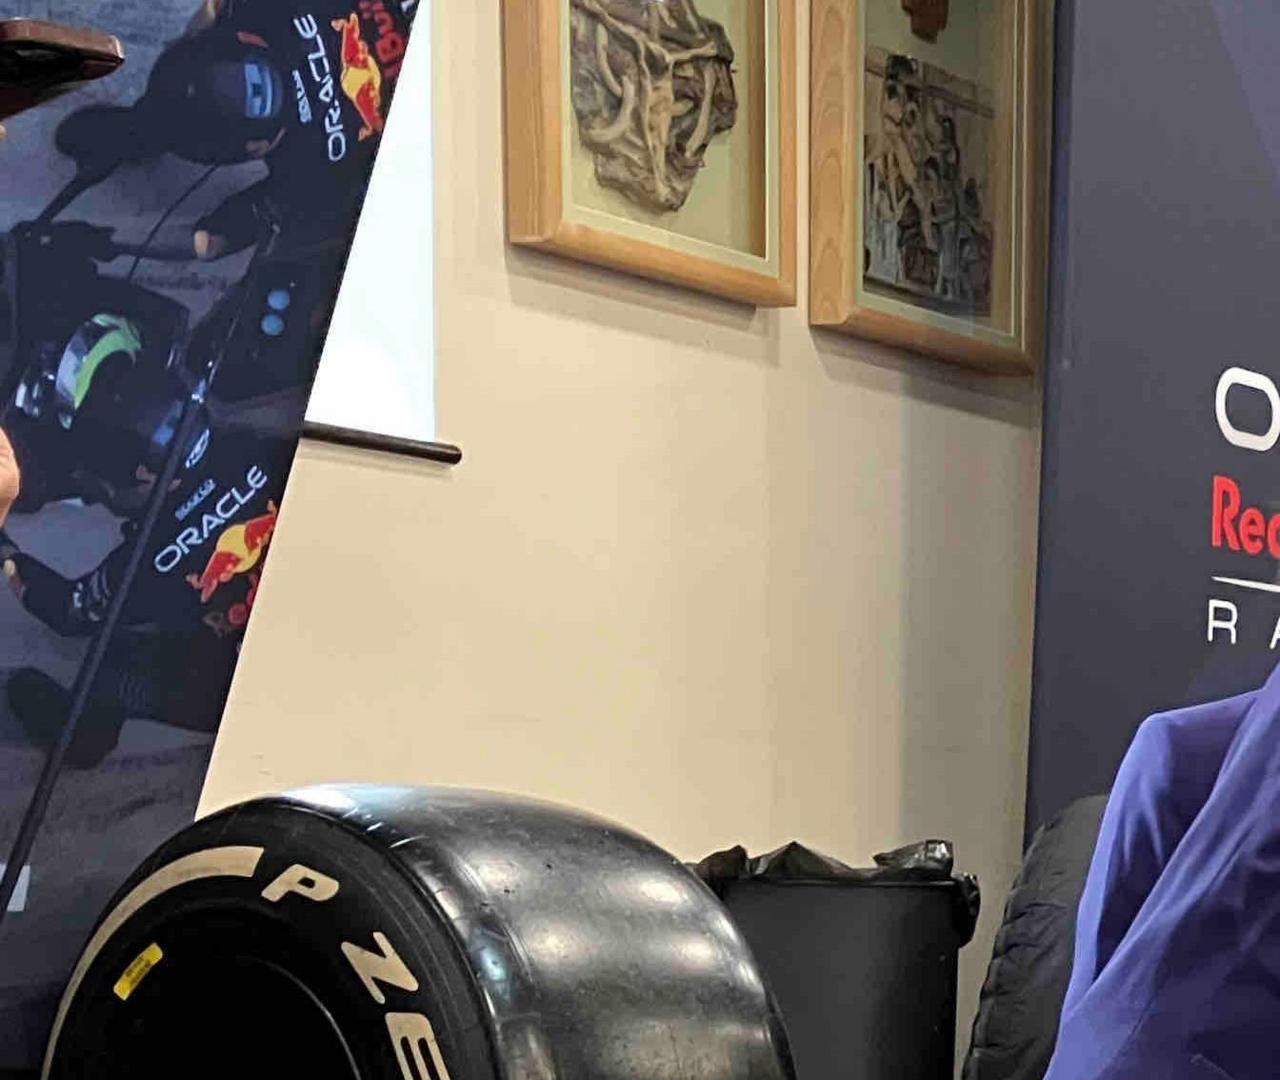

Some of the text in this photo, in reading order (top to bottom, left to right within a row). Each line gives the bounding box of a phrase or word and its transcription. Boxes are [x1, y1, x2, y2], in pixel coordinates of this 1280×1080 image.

[293, 14, 346, 161] ORACLE
[154, 465, 267, 572] ORACLE
[261, 863, 339, 901] P
